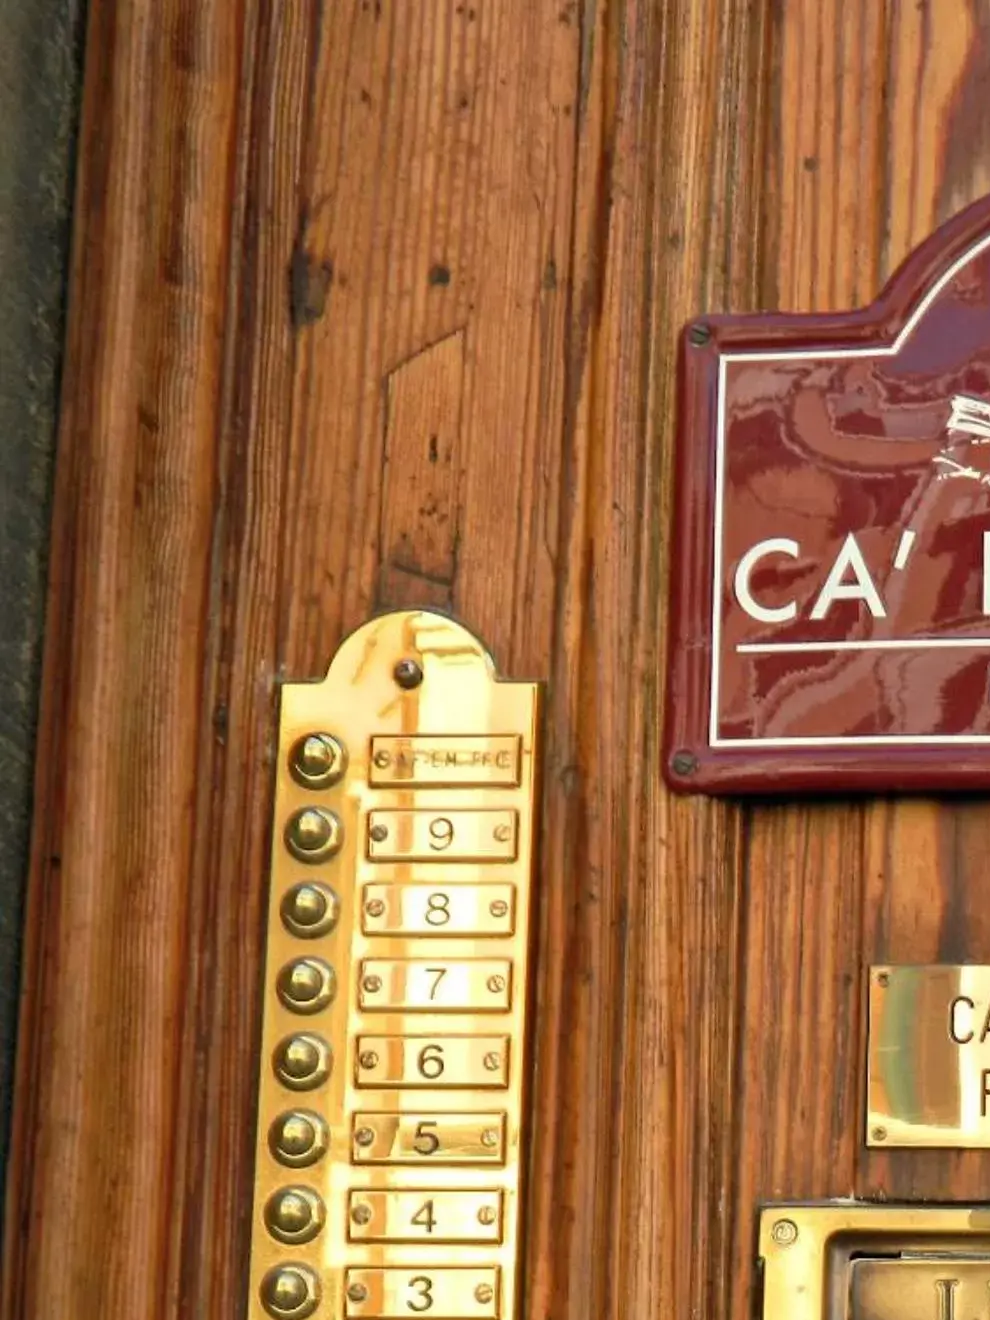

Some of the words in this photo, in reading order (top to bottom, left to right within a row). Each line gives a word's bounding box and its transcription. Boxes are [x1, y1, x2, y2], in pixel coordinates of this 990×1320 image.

[733, 529, 916, 622] CA'
[428, 817, 455, 850] 9
[424, 892, 451, 925] 8
[424, 968, 447, 1000] 7
[416, 1043, 444, 1079] 6
[412, 1120, 440, 1156] 5
[410, 1199, 437, 1233] 4
[406, 1275, 434, 1312] 3
